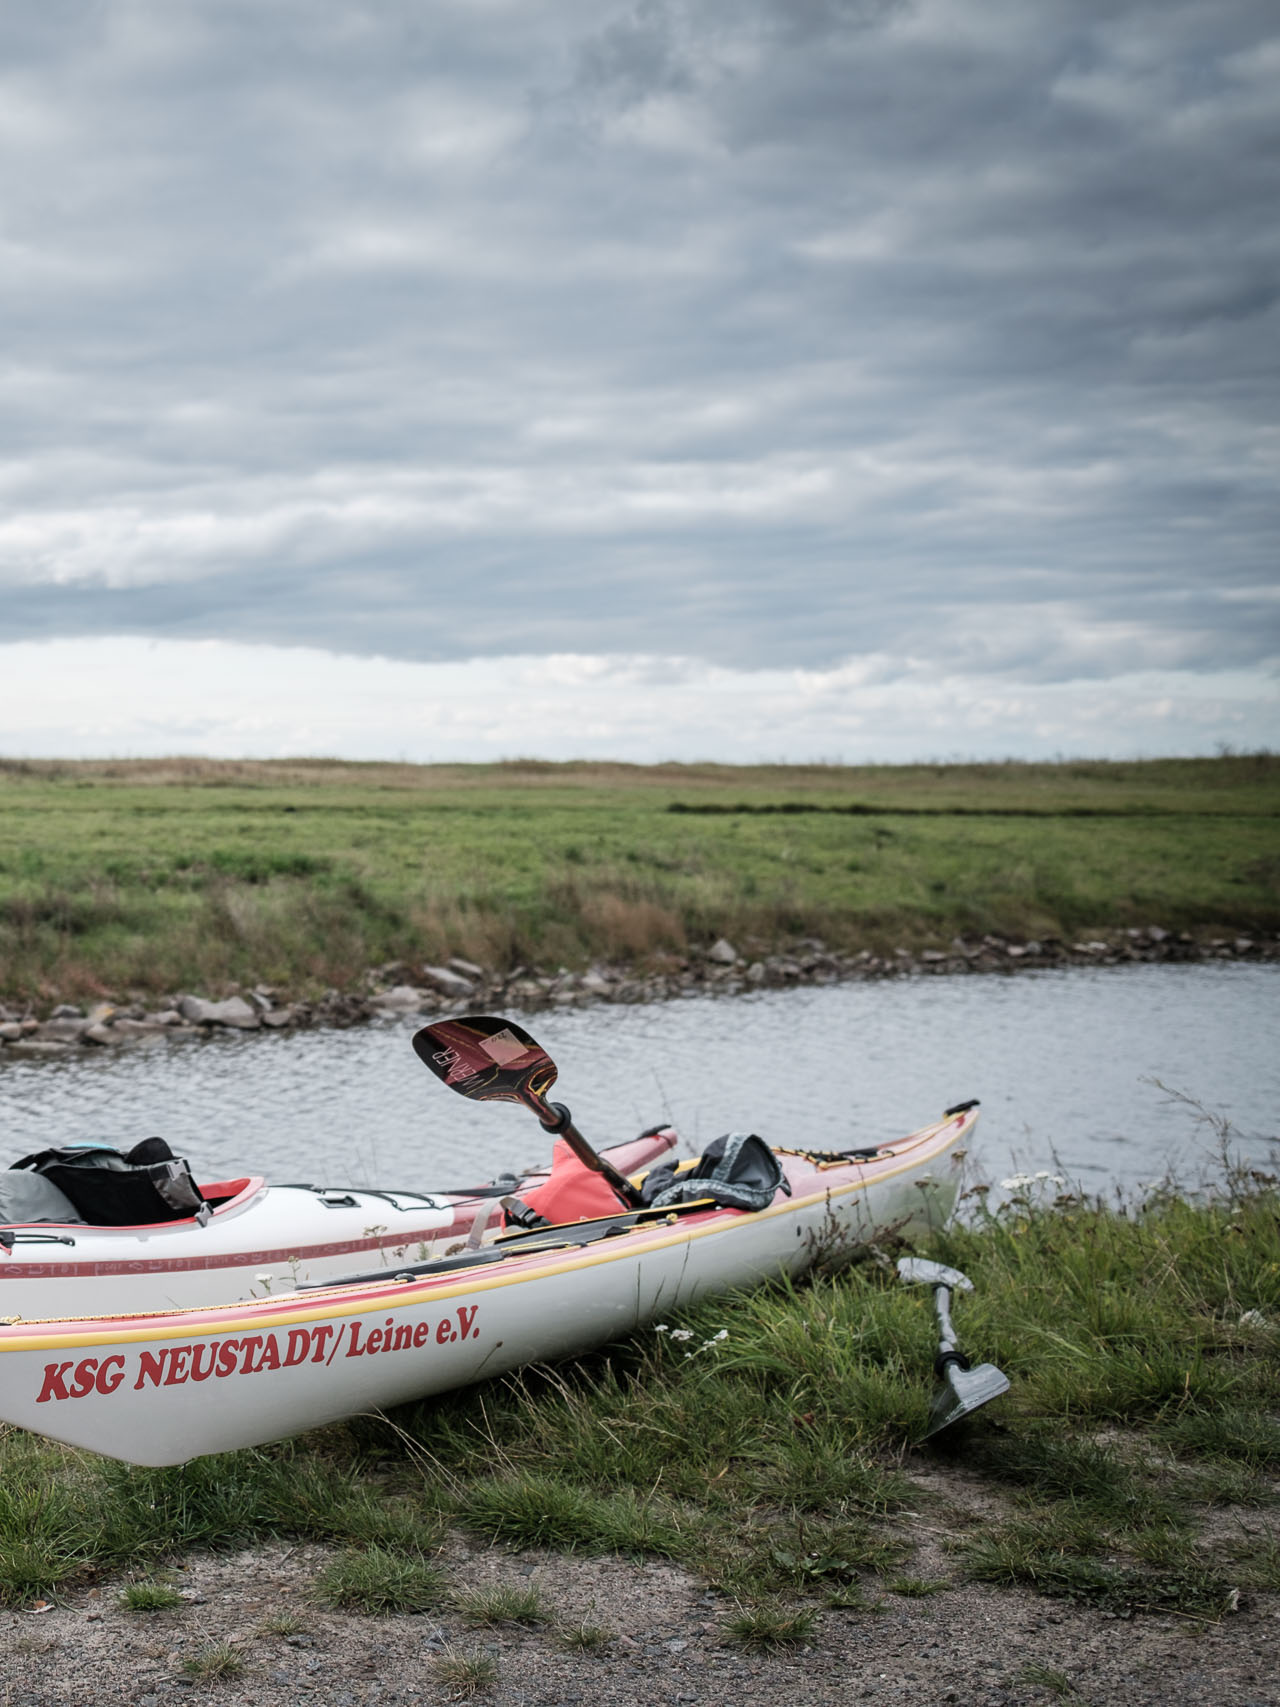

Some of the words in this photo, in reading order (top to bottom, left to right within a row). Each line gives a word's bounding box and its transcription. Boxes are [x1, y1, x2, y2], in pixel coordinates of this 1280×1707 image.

[432, 1046, 485, 1090] WERNER
[36, 1354, 125, 1403] KSG
[133, 1318, 428, 1389] NEUSTADT/Leine
[436, 1304, 481, 1344] e.V.
